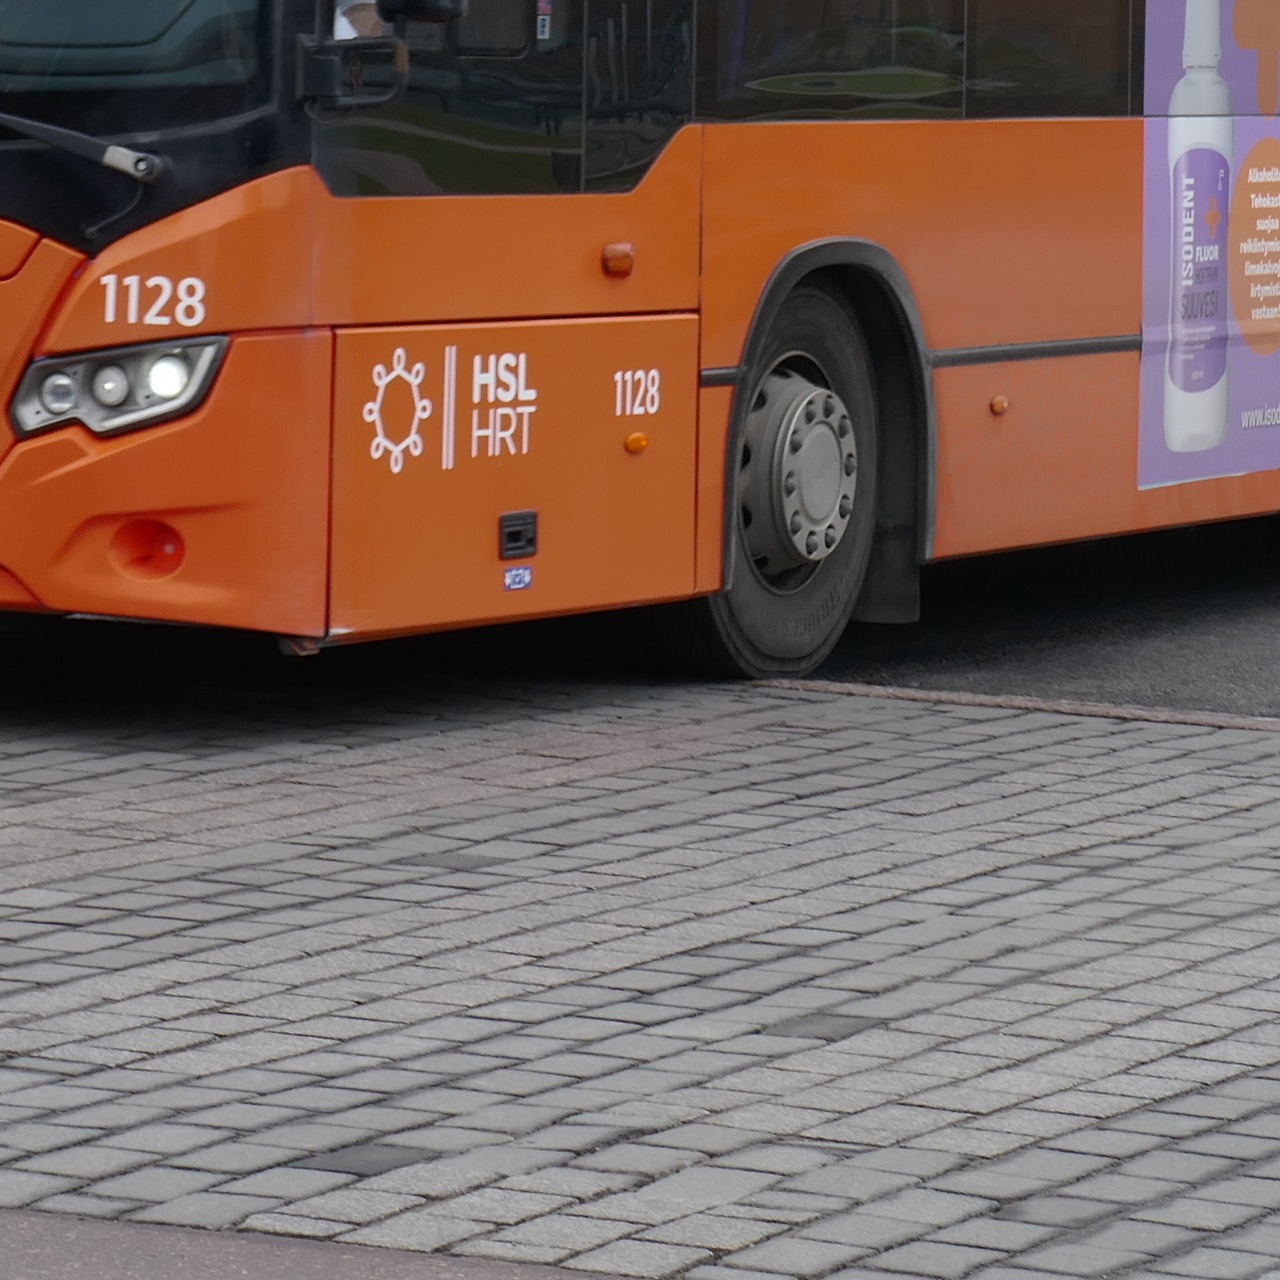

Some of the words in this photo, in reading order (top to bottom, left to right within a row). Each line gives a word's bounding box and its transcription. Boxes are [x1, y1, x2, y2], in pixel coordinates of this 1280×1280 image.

[1182, 174, 1195, 286] ISODENT
[1256, 215, 1280, 234] suojaa
[1195, 245, 1219, 262] FLUOR
[100, 273, 207, 326] 1128
[1181, 290, 1218, 320] SUUVESI
[472, 353, 537, 404] HSL
[613, 369, 661, 416] 1128
[471, 406, 536, 458] HRT
